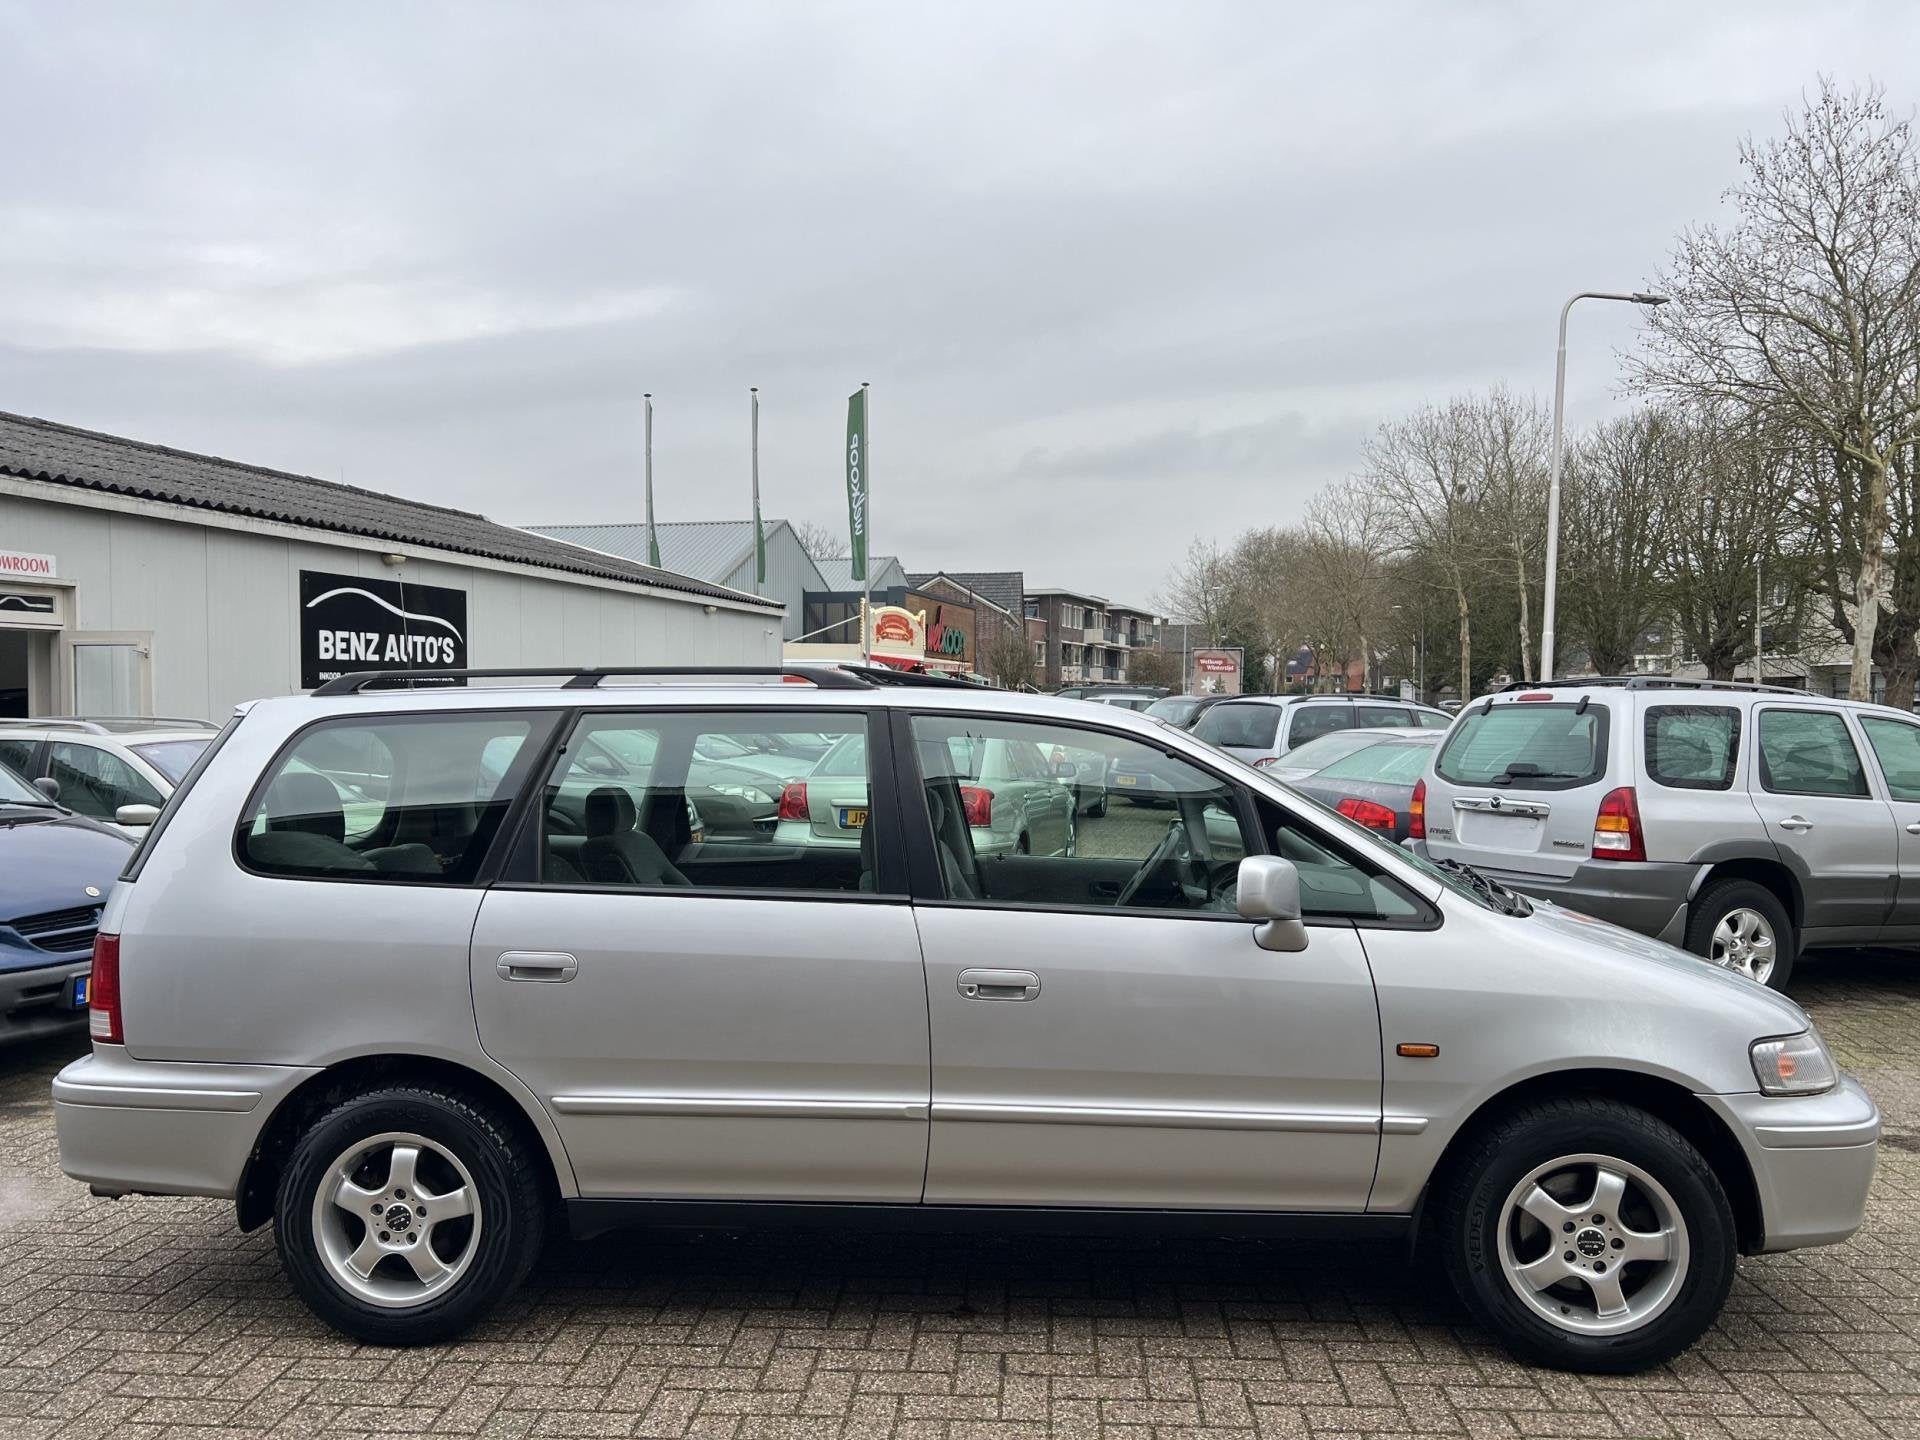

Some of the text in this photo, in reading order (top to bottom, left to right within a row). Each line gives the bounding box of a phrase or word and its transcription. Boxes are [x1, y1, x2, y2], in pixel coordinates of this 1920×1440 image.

[0, 555, 49, 573] WROOM
[319, 630, 455, 664] BENZ AUTO'S
[851, 812, 867, 824] JP
